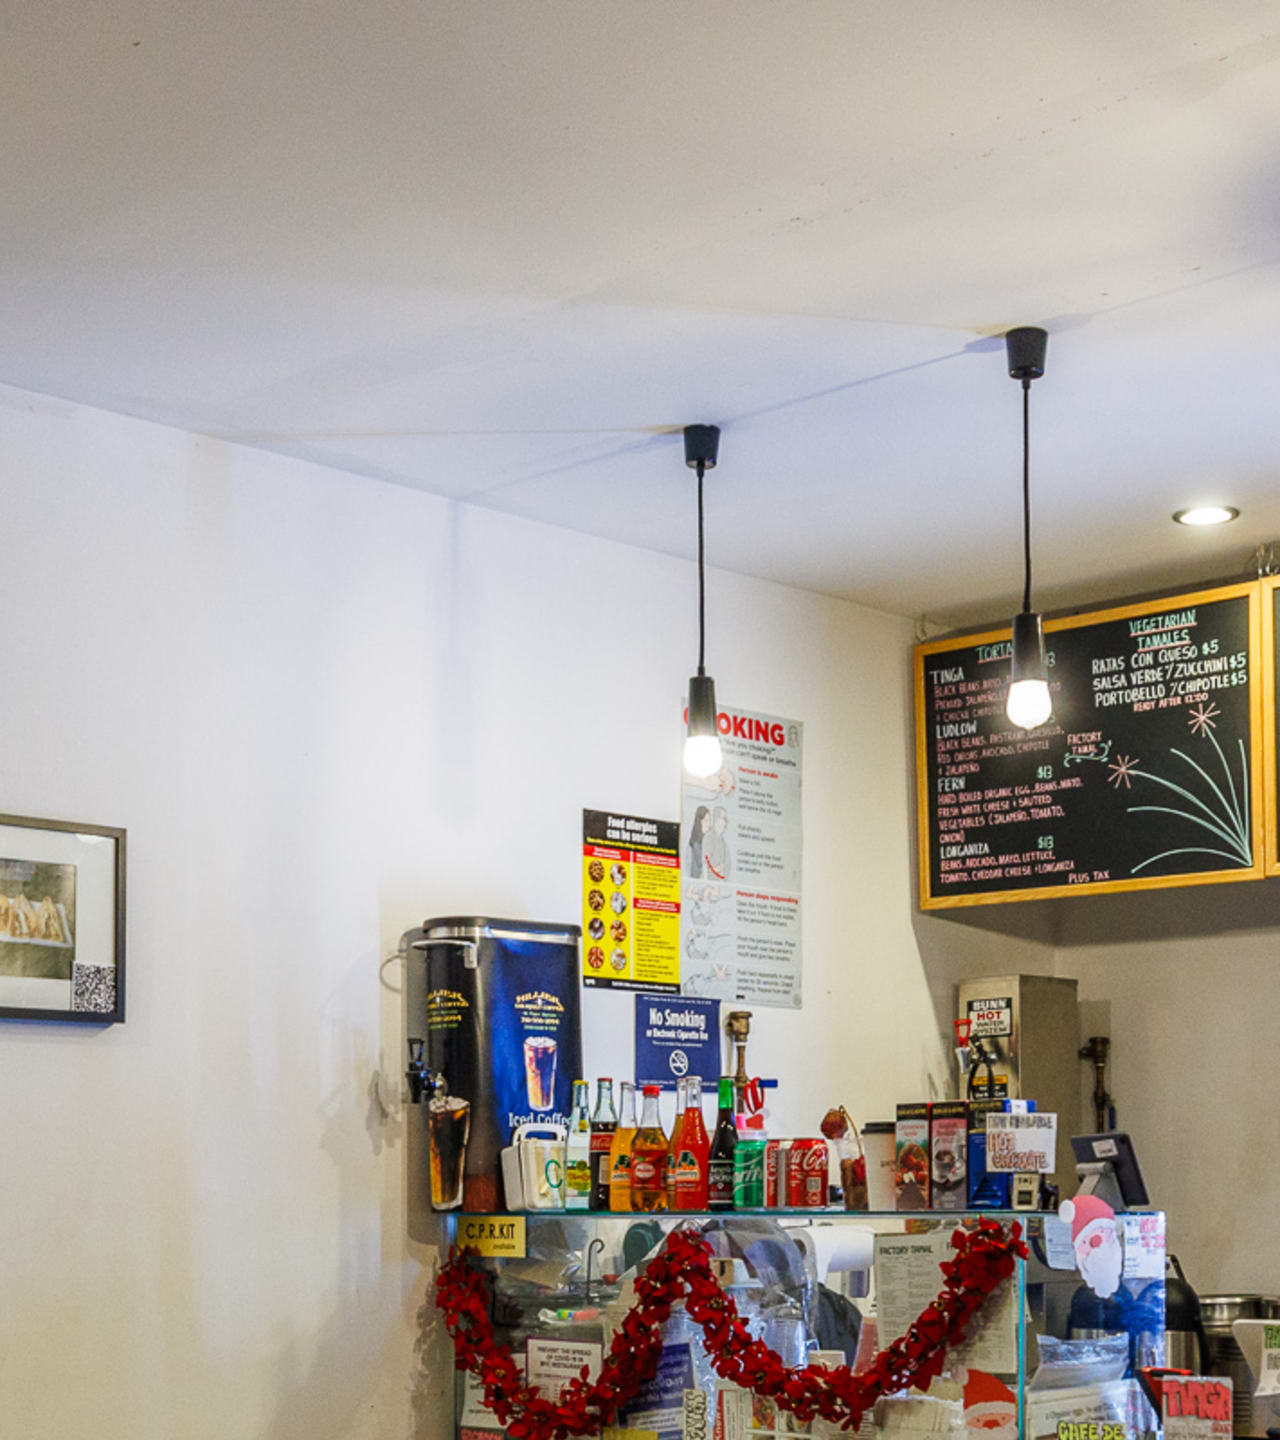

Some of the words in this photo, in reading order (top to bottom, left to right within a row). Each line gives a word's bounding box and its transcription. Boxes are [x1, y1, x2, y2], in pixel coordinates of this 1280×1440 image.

[1129, 610, 1196, 633] VEGETARIAN
[1137, 630, 1190, 649] TAMALES
[1092, 657, 1124, 674] RAJAS
[1131, 651, 1154, 667] CON
[1159, 645, 1198, 662] QUESO
[1202, 639, 1219, 655] $5
[929, 667, 964, 685] TINGA
[1093, 674, 1127, 691] SALSA
[1130, 668, 1164, 685] VERDE
[1230, 653, 1246, 670] $5
[1095, 684, 1165, 708] PORTOBELLO
[1231, 670, 1247, 686] $5
[936, 720, 977, 739] LUDLOW
[937, 777, 966, 792] FERN
[973, 1000, 1007, 1011] BUNN
[649, 1008, 663, 1025] No
[665, 1009, 706, 1030] Smoking
[977, 1011, 1002, 1021] HOT
[1101, 1423, 1124, 1440] DE
